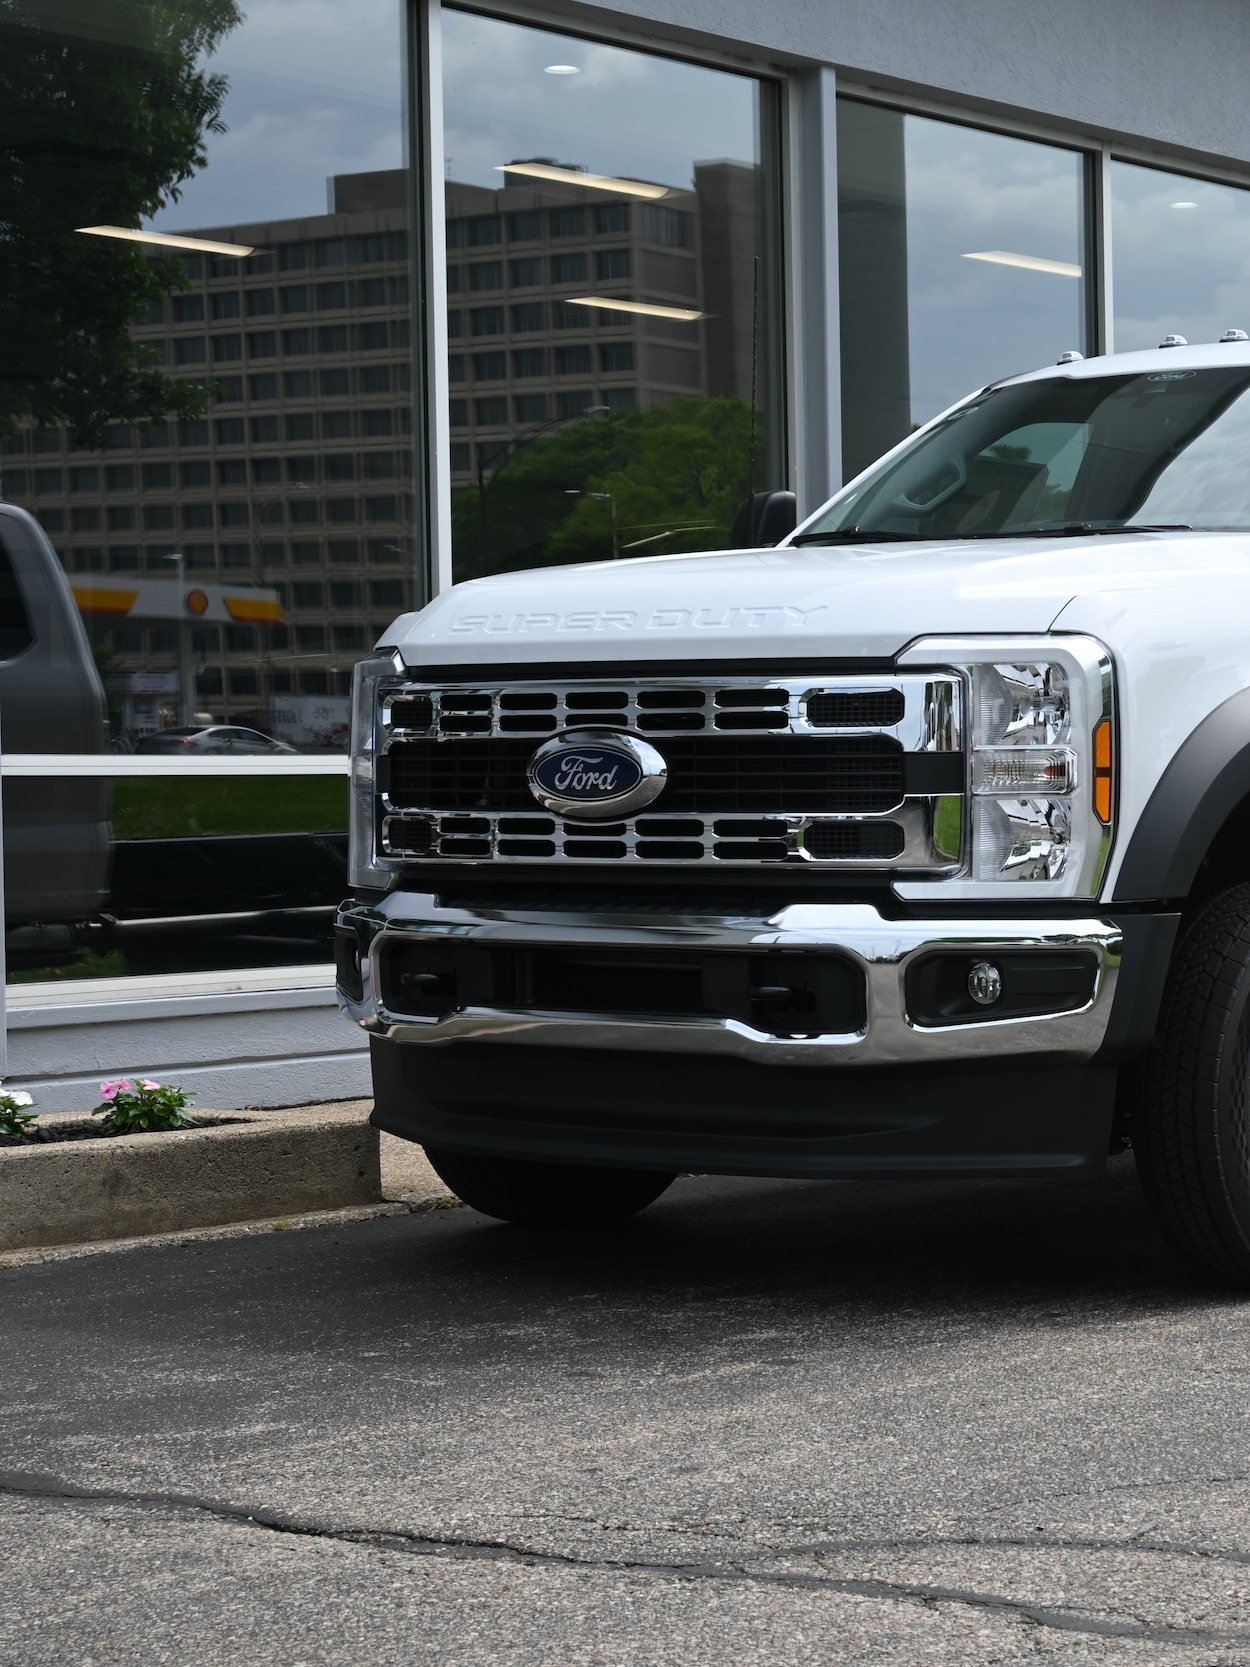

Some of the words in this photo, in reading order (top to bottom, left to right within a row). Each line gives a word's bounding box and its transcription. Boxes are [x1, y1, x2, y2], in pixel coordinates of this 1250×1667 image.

[448, 610, 639, 636] SUPER
[646, 604, 829, 631] DUTY
[554, 755, 620, 790] Ford
